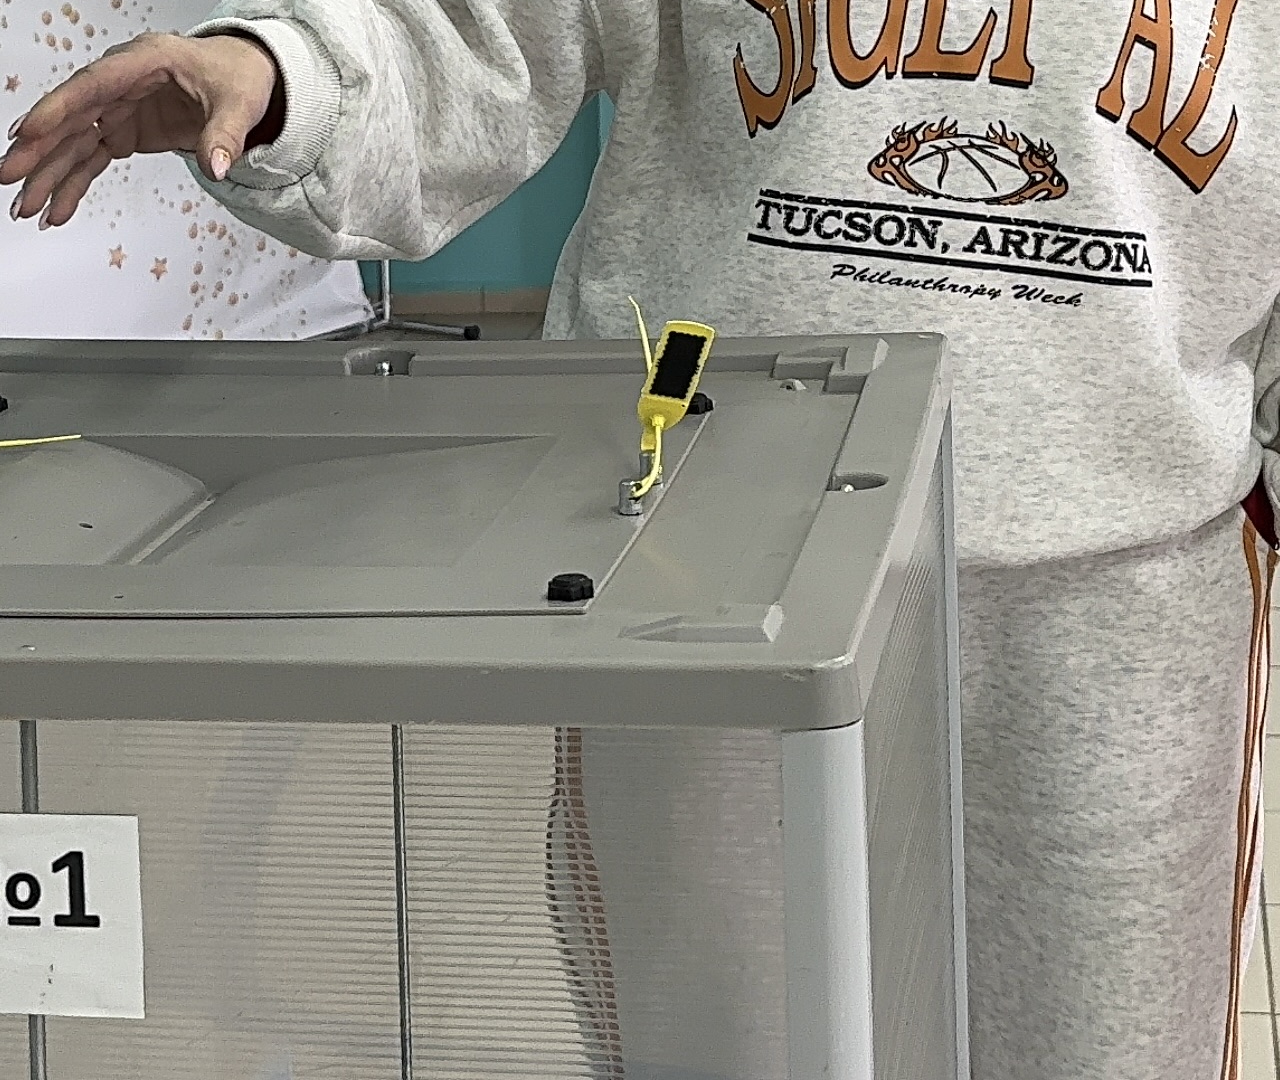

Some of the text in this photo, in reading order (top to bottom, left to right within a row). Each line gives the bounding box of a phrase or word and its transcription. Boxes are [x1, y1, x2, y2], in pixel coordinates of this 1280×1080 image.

[755, 199, 1151, 274] TUCSON, ARIZONA
[830, 263, 1083, 307] Philanthropy Week
